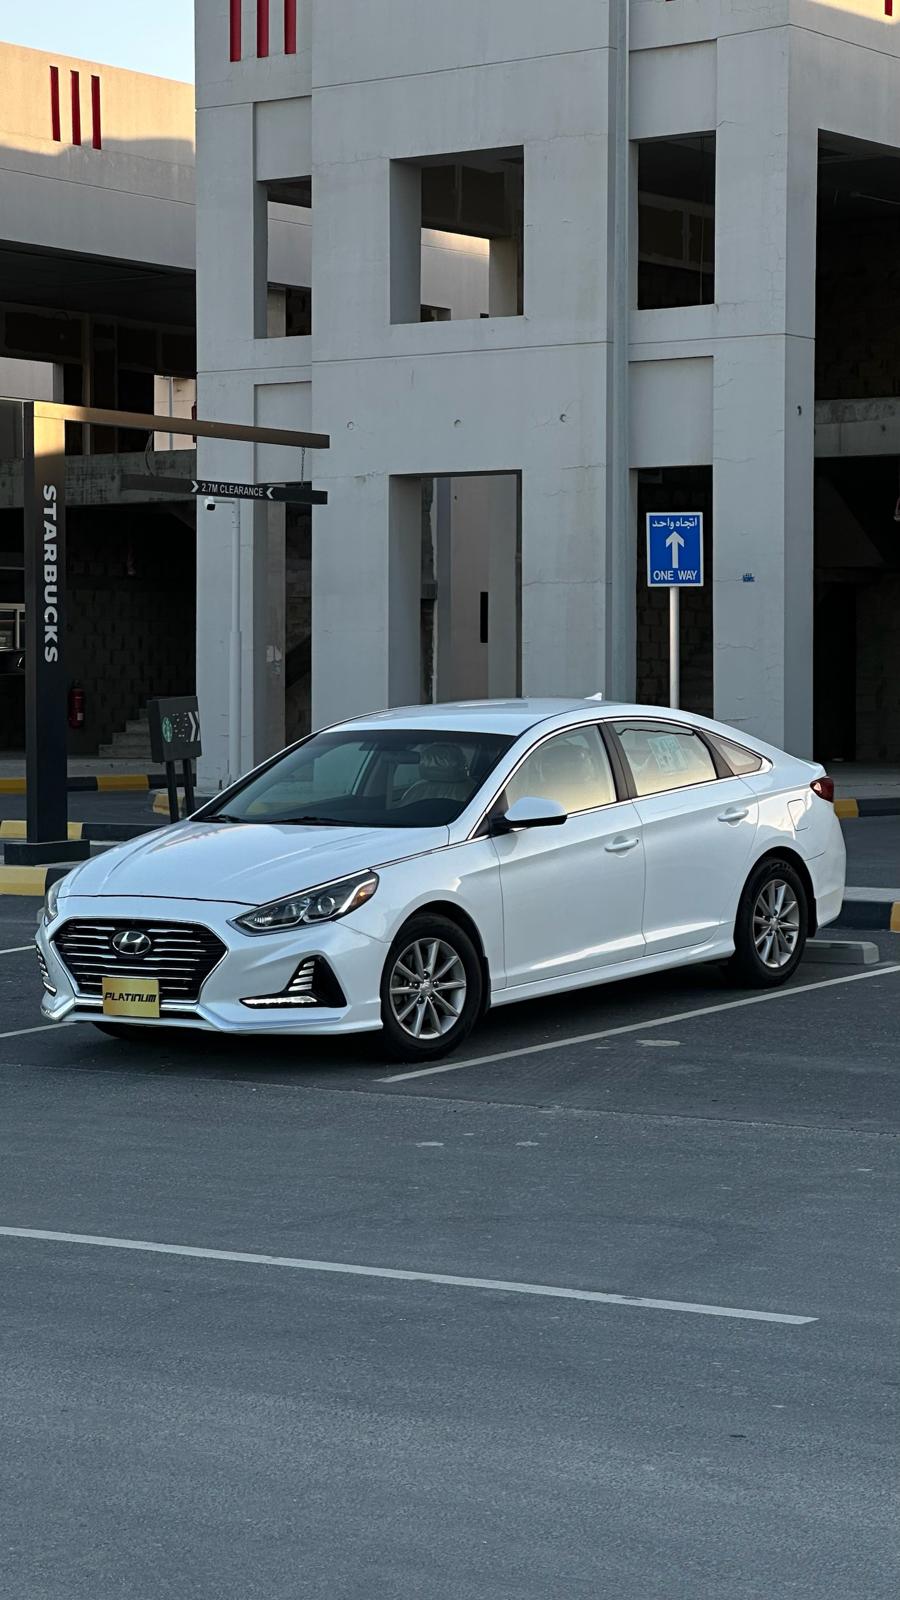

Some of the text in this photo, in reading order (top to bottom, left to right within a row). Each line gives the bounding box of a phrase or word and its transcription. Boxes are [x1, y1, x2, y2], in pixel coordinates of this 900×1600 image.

[201, 483, 264, 497] 2.7M CLEARANCE
[652, 517, 697, 529] اتجاه واحد
[43, 484, 58, 663] STARBUCKS
[653, 570, 698, 581] ONE WAY
